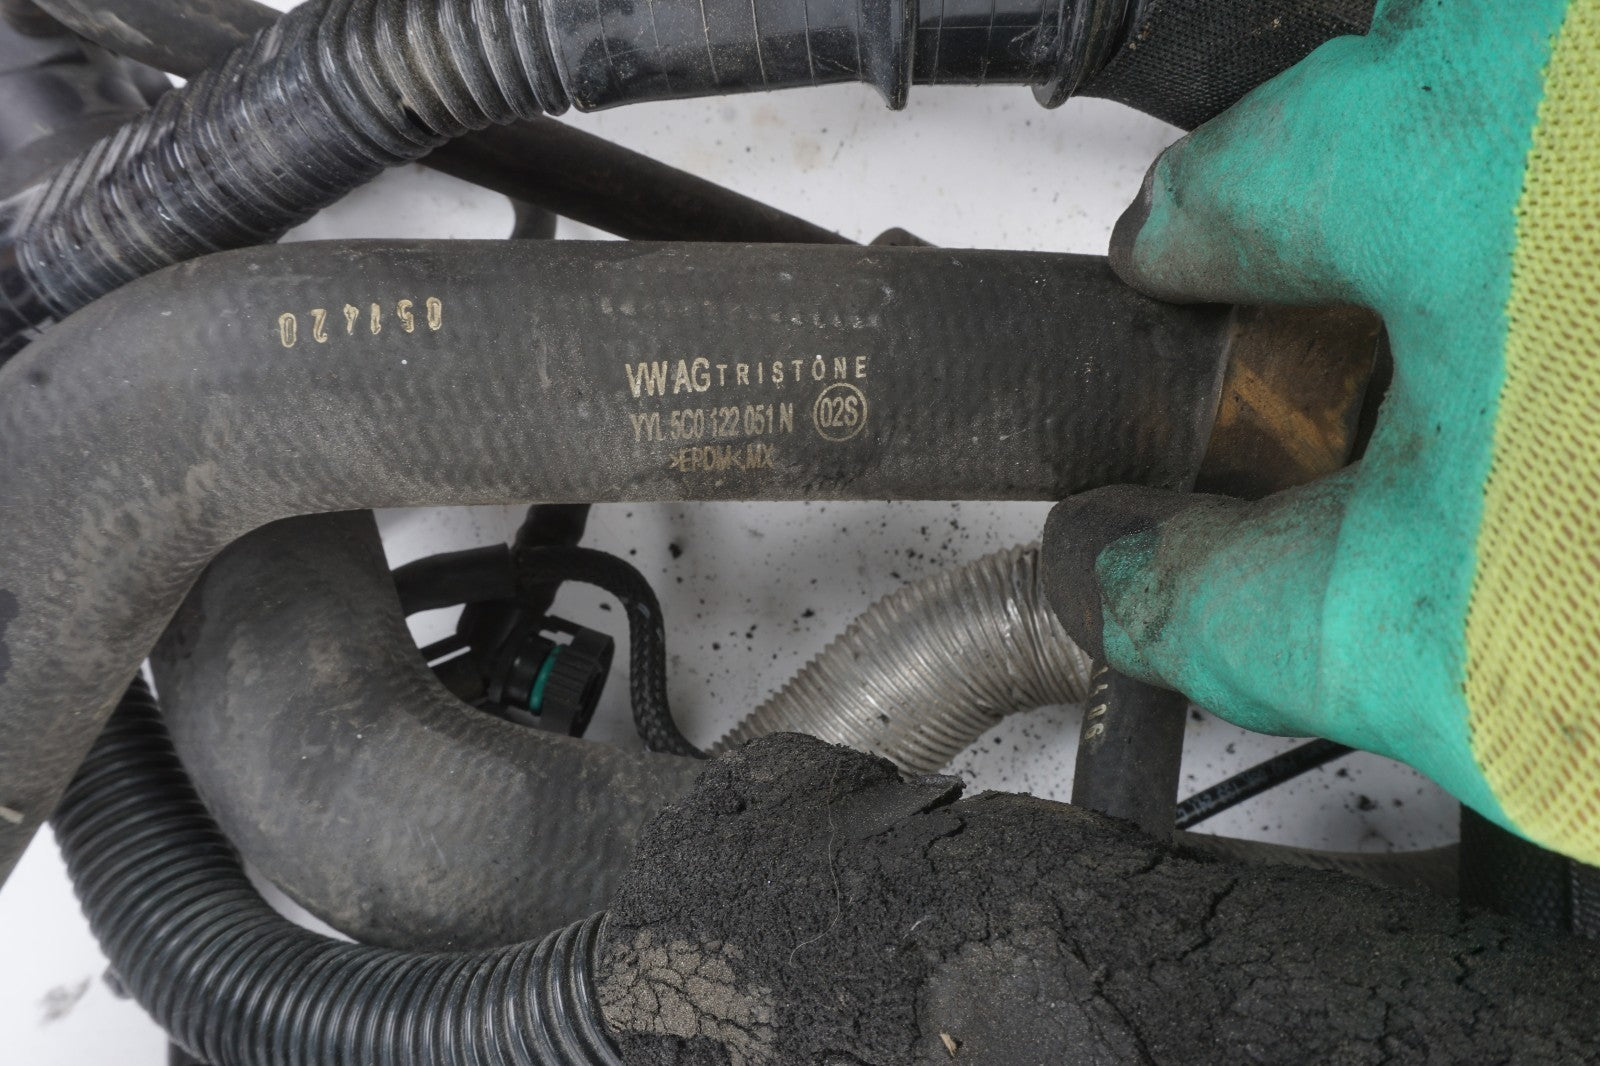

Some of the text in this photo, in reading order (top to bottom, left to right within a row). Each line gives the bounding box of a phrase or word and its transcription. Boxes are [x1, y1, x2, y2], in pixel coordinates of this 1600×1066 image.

[716, 355, 868, 388] TRISTONE
[710, 406, 740, 438] 122
[744, 403, 774, 436] 051
[779, 401, 794, 434] N
